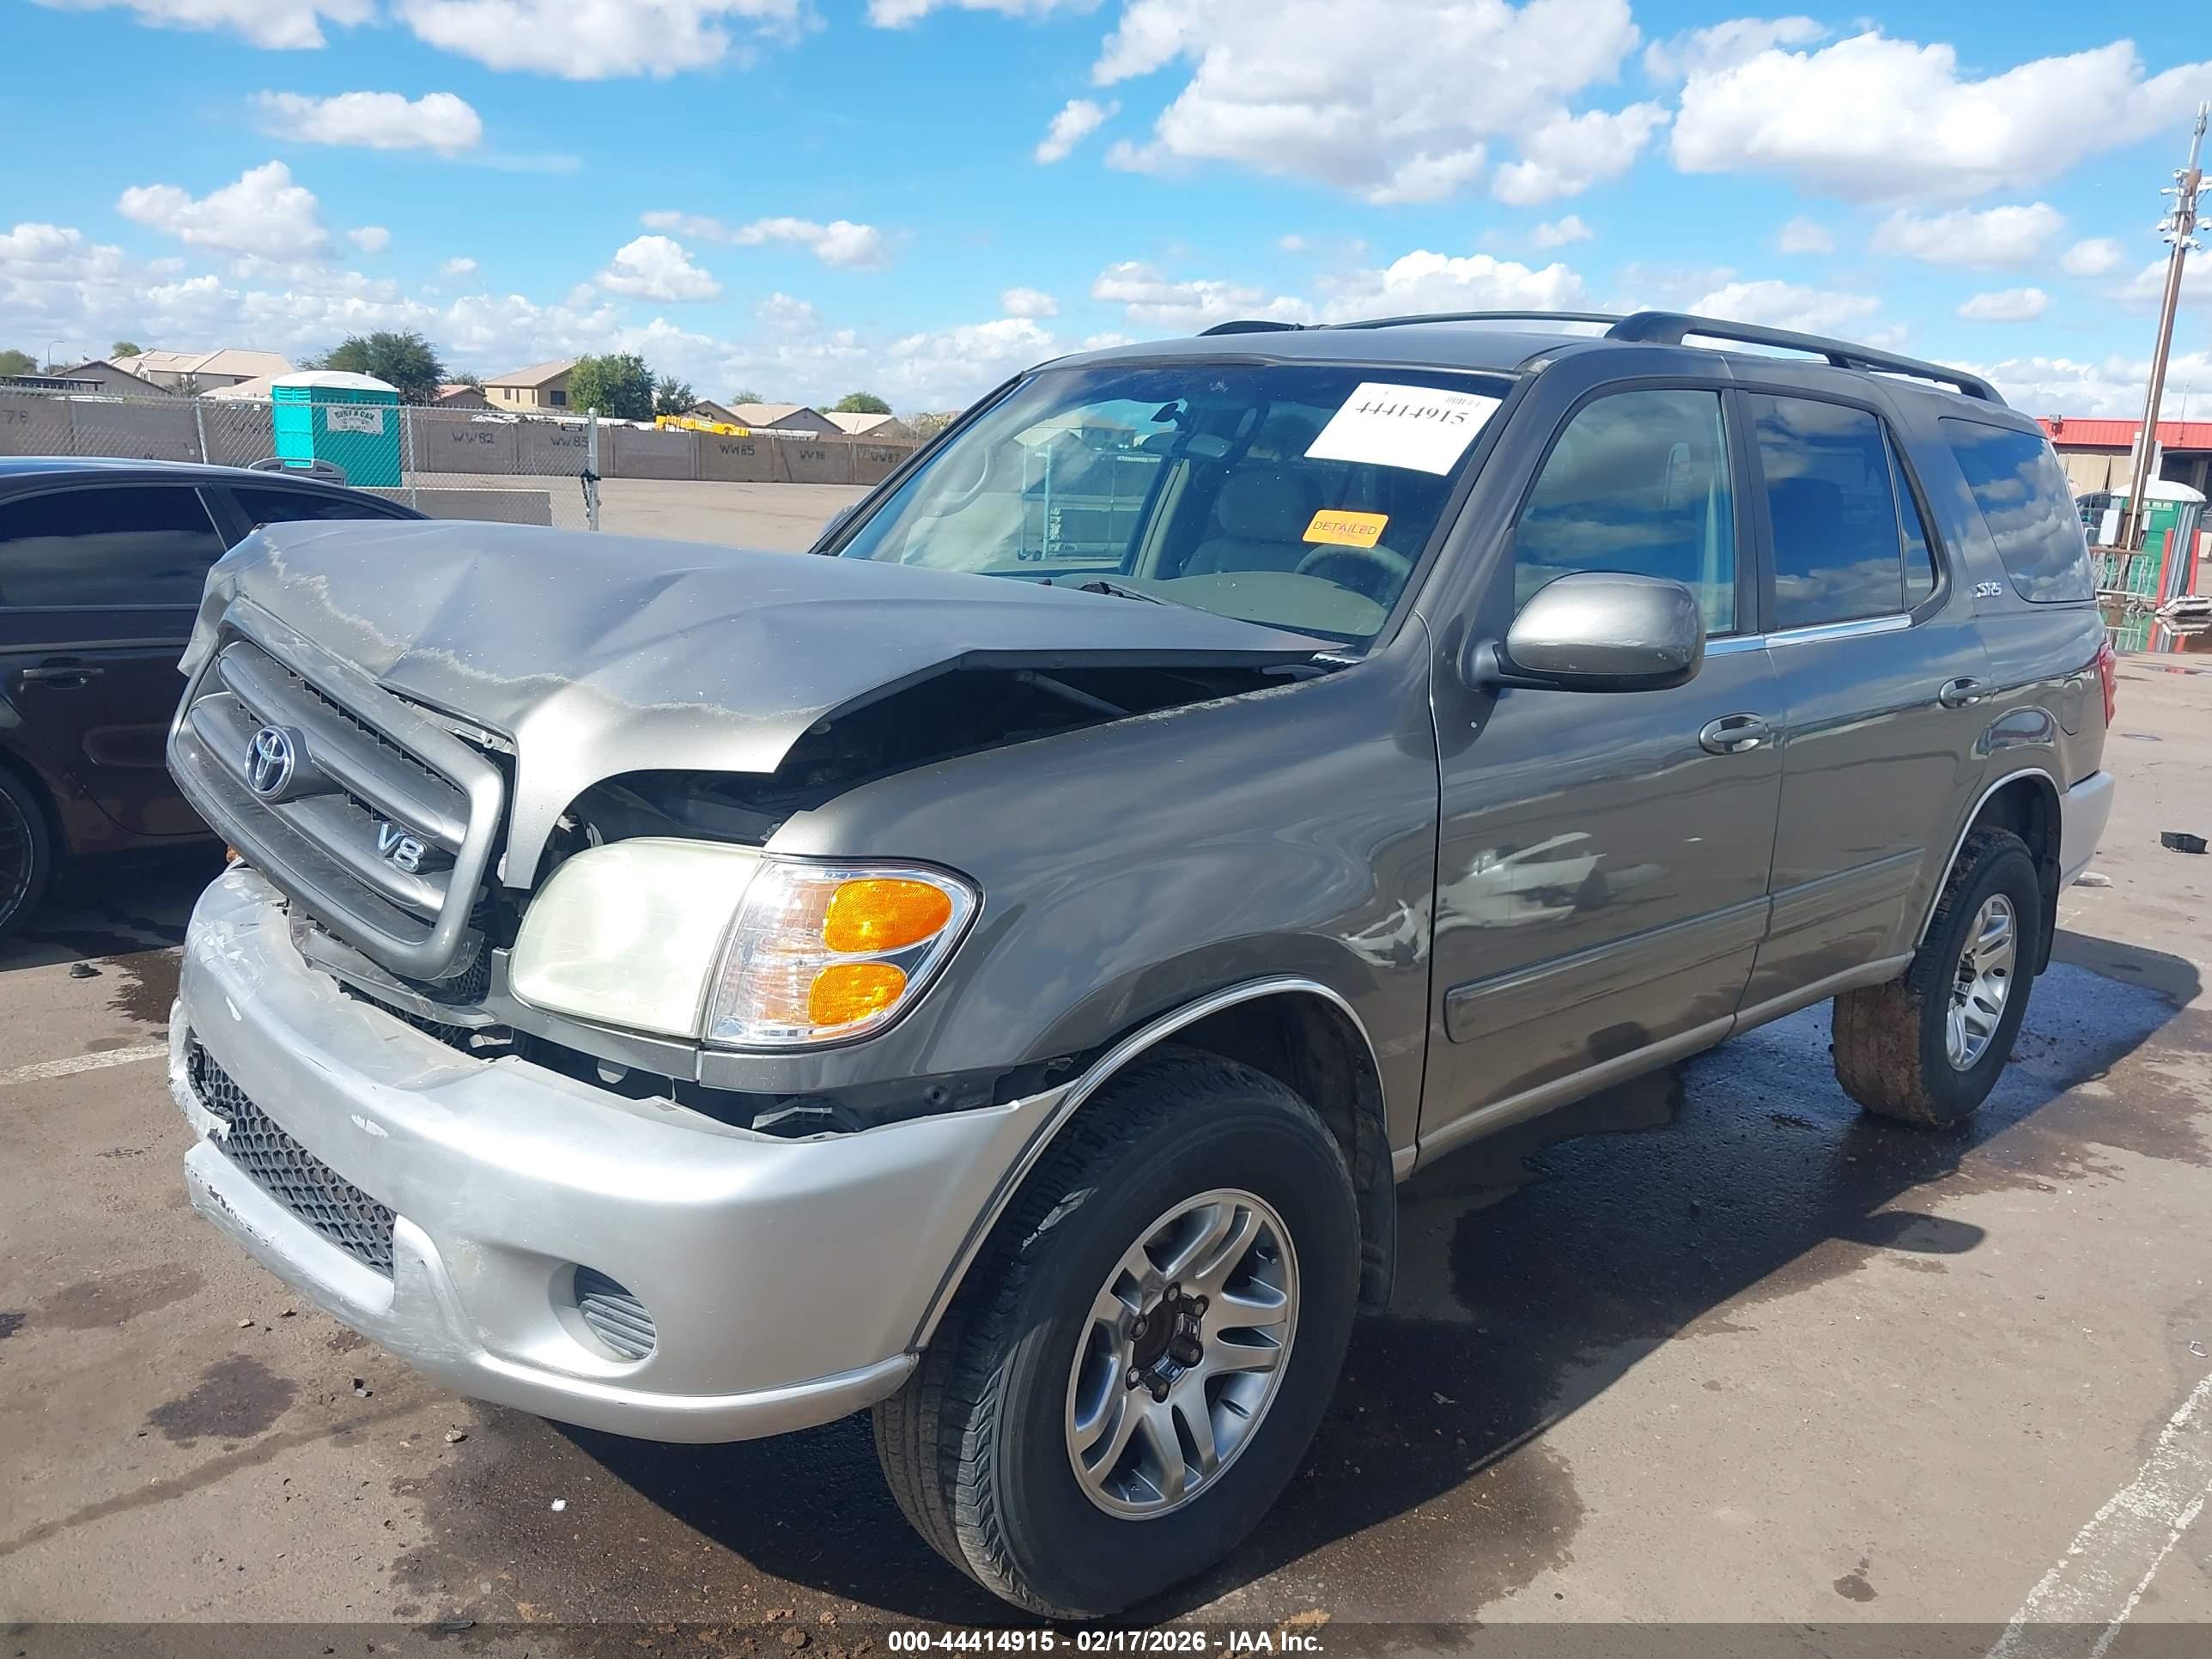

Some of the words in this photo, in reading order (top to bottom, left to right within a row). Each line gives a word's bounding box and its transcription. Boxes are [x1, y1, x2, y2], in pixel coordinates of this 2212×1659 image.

[1355, 401, 1470, 426] 44414915
[720, 444, 756, 456] WW85
[1312, 520, 1377, 535] DETAILED
[377, 822, 426, 873] V8
